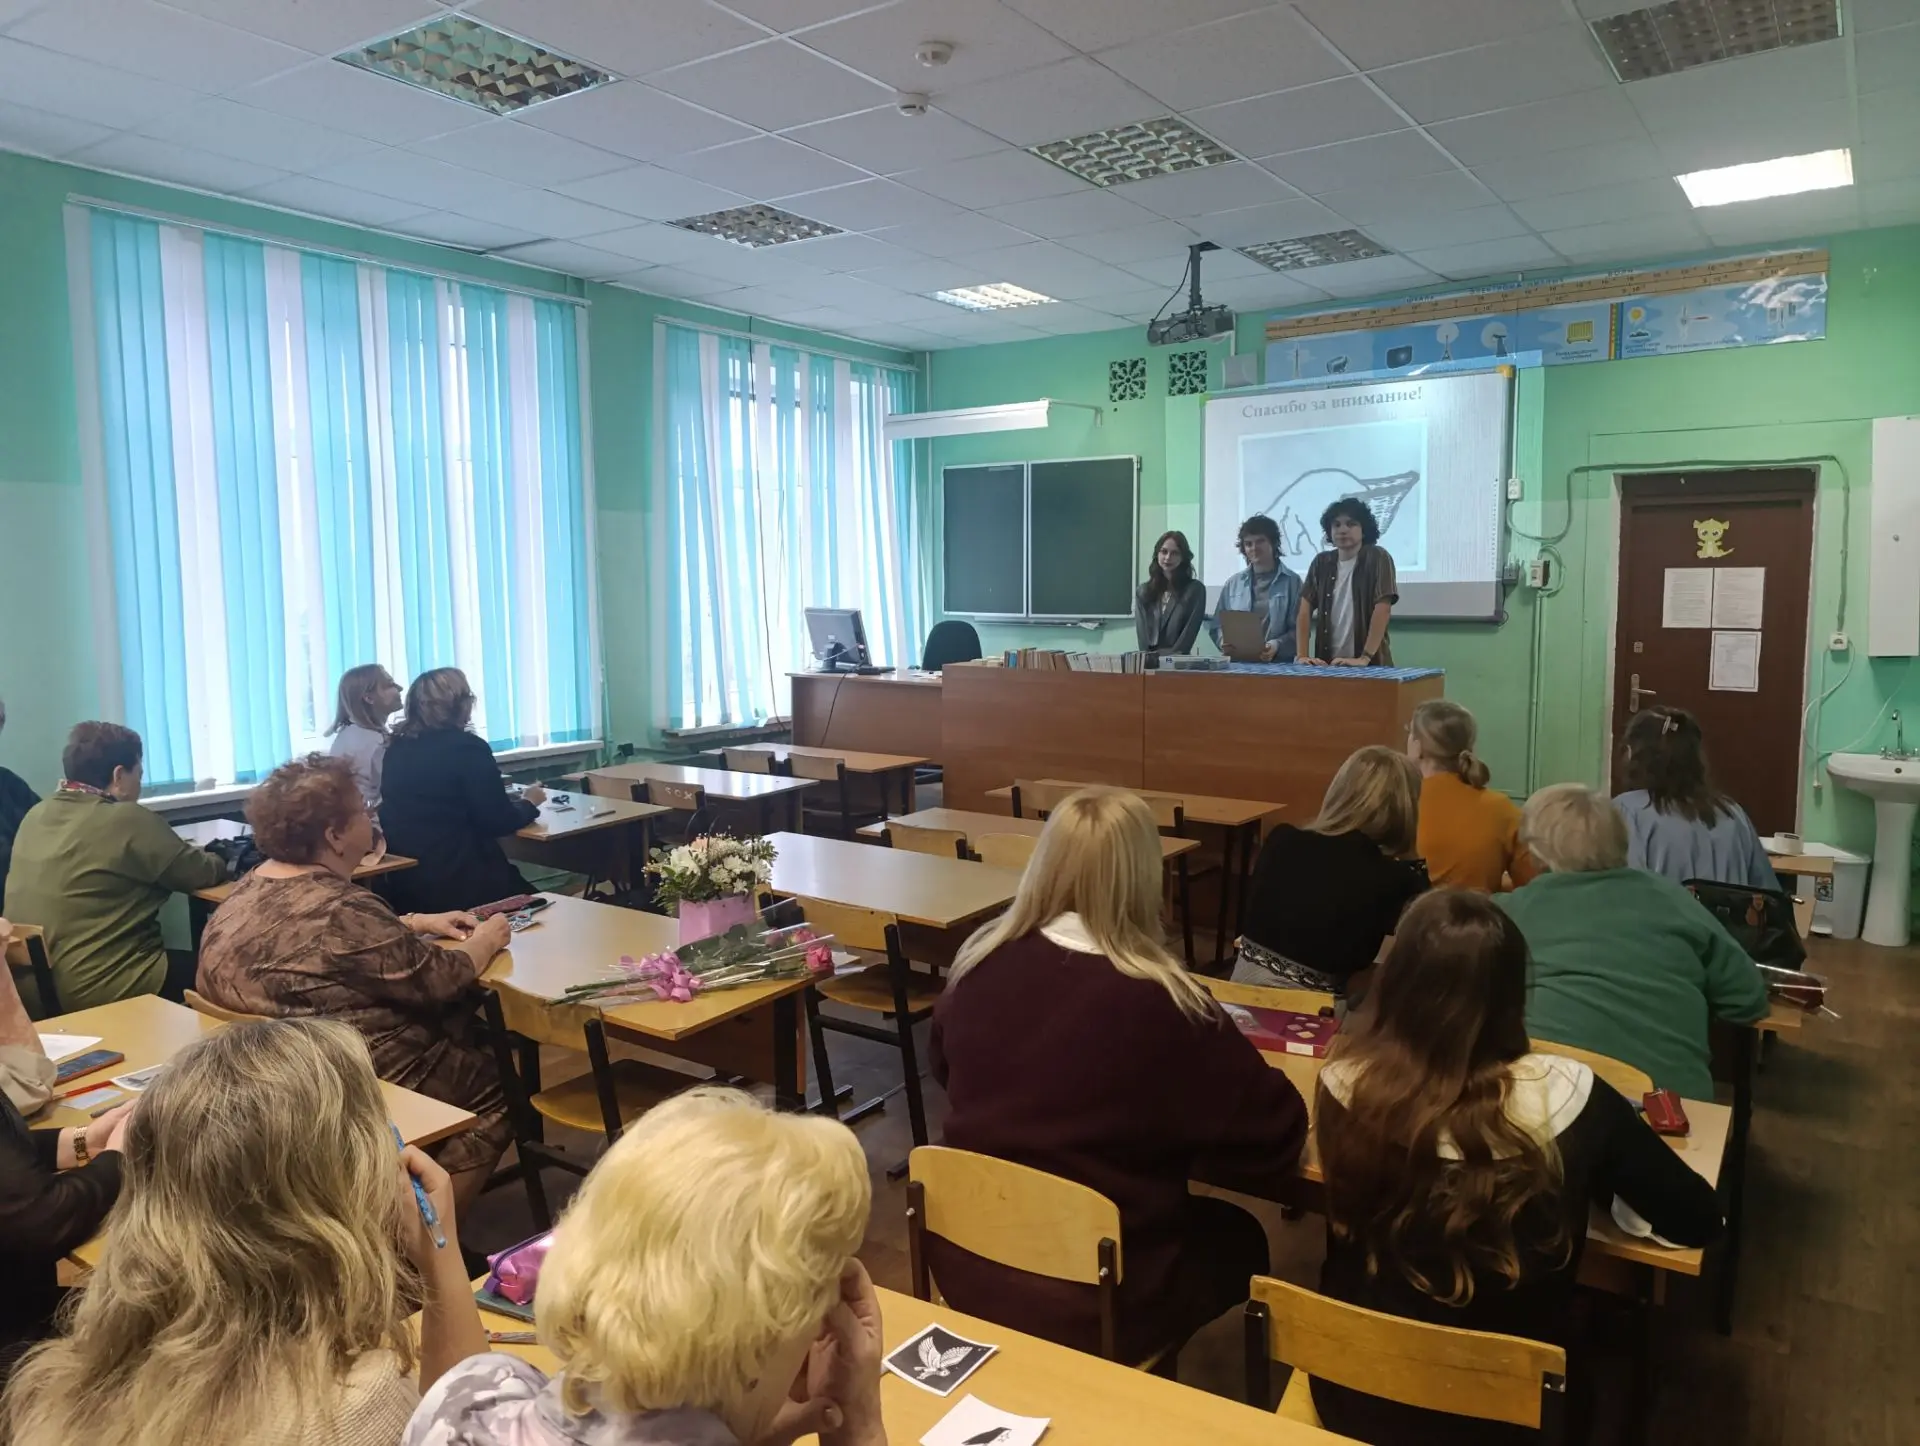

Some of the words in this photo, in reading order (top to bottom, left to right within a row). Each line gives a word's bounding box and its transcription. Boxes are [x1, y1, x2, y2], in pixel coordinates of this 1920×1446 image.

[1242, 400, 1306, 419] Спасибо
[1311, 401, 1327, 411] за
[1331, 387, 1423, 410] внимание!
